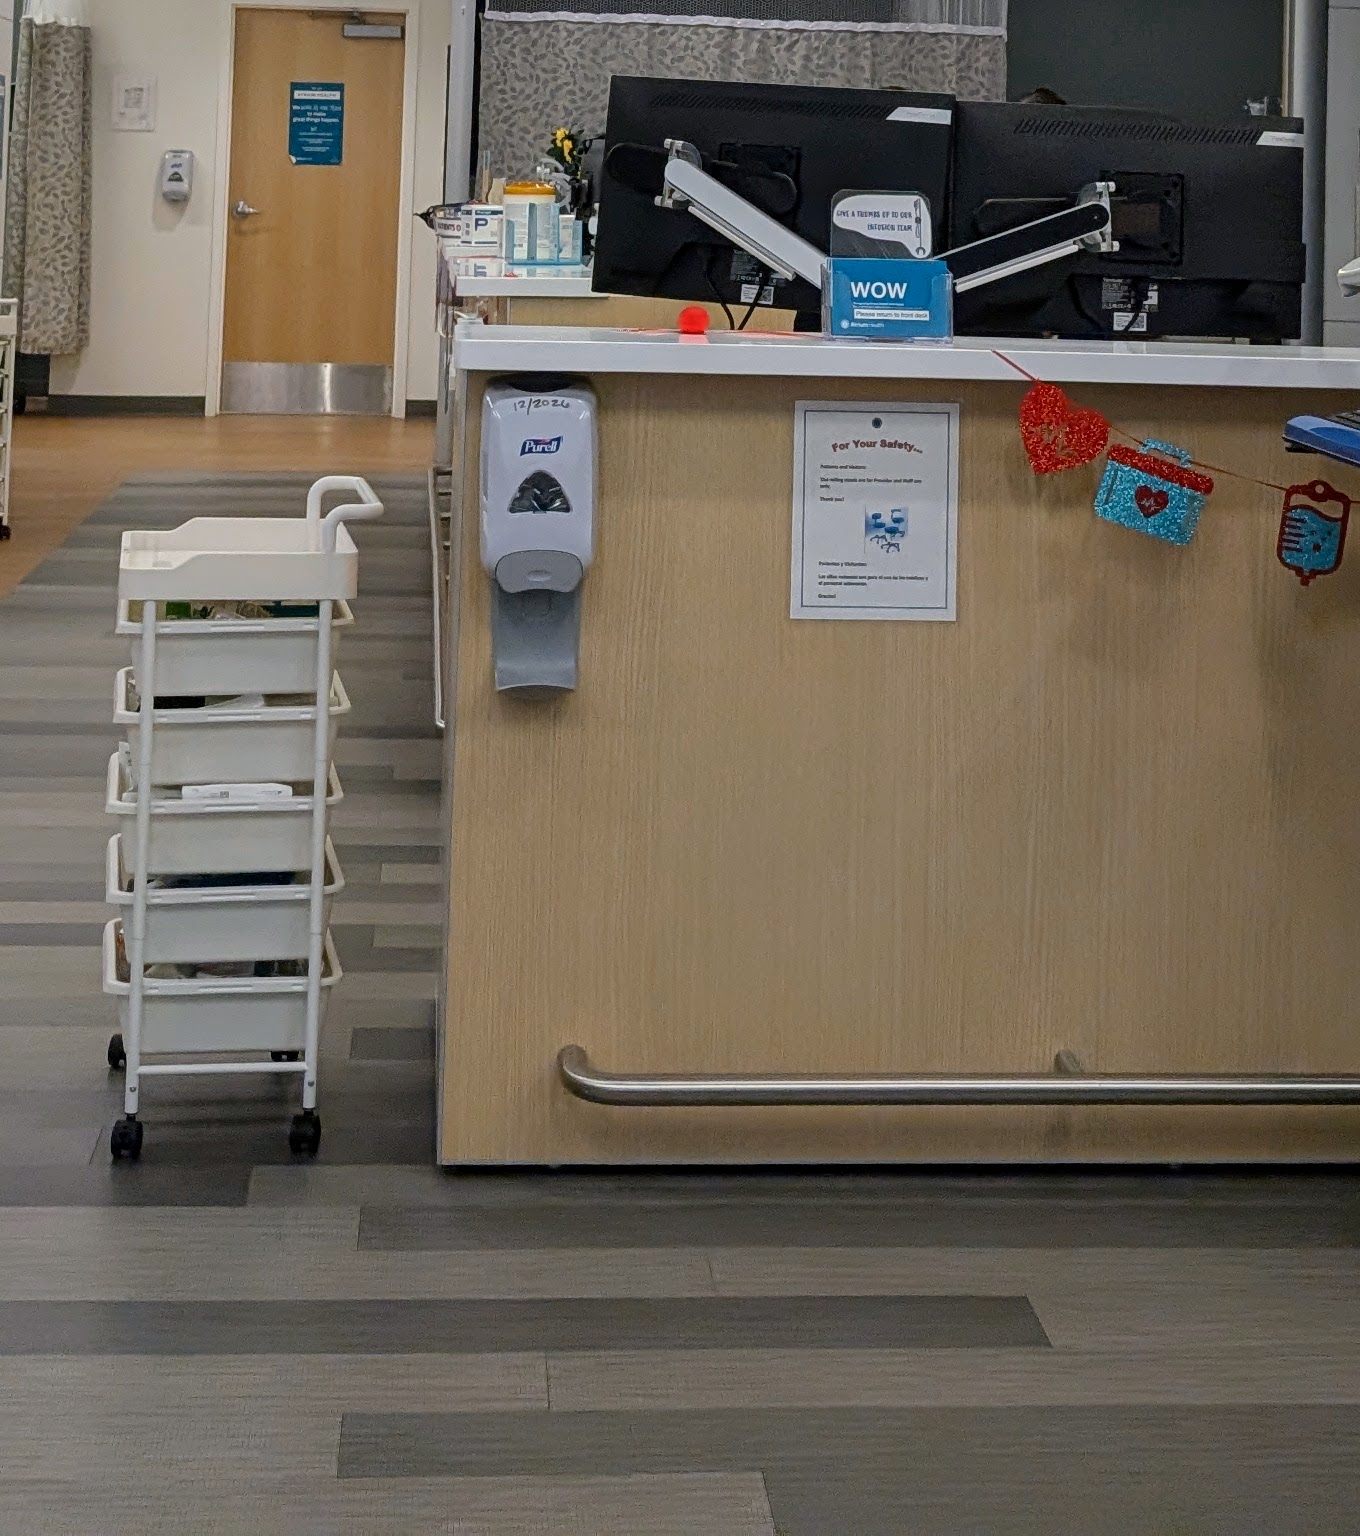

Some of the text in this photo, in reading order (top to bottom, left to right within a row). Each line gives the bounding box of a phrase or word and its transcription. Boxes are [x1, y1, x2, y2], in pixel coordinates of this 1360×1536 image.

[474, 217, 488, 231] P
[850, 281, 908, 299] WOW
[513, 398, 570, 415] 12/2026
[525, 440, 558, 452] Purell
[831, 441, 850, 452] For
[852, 439, 877, 449] Your
